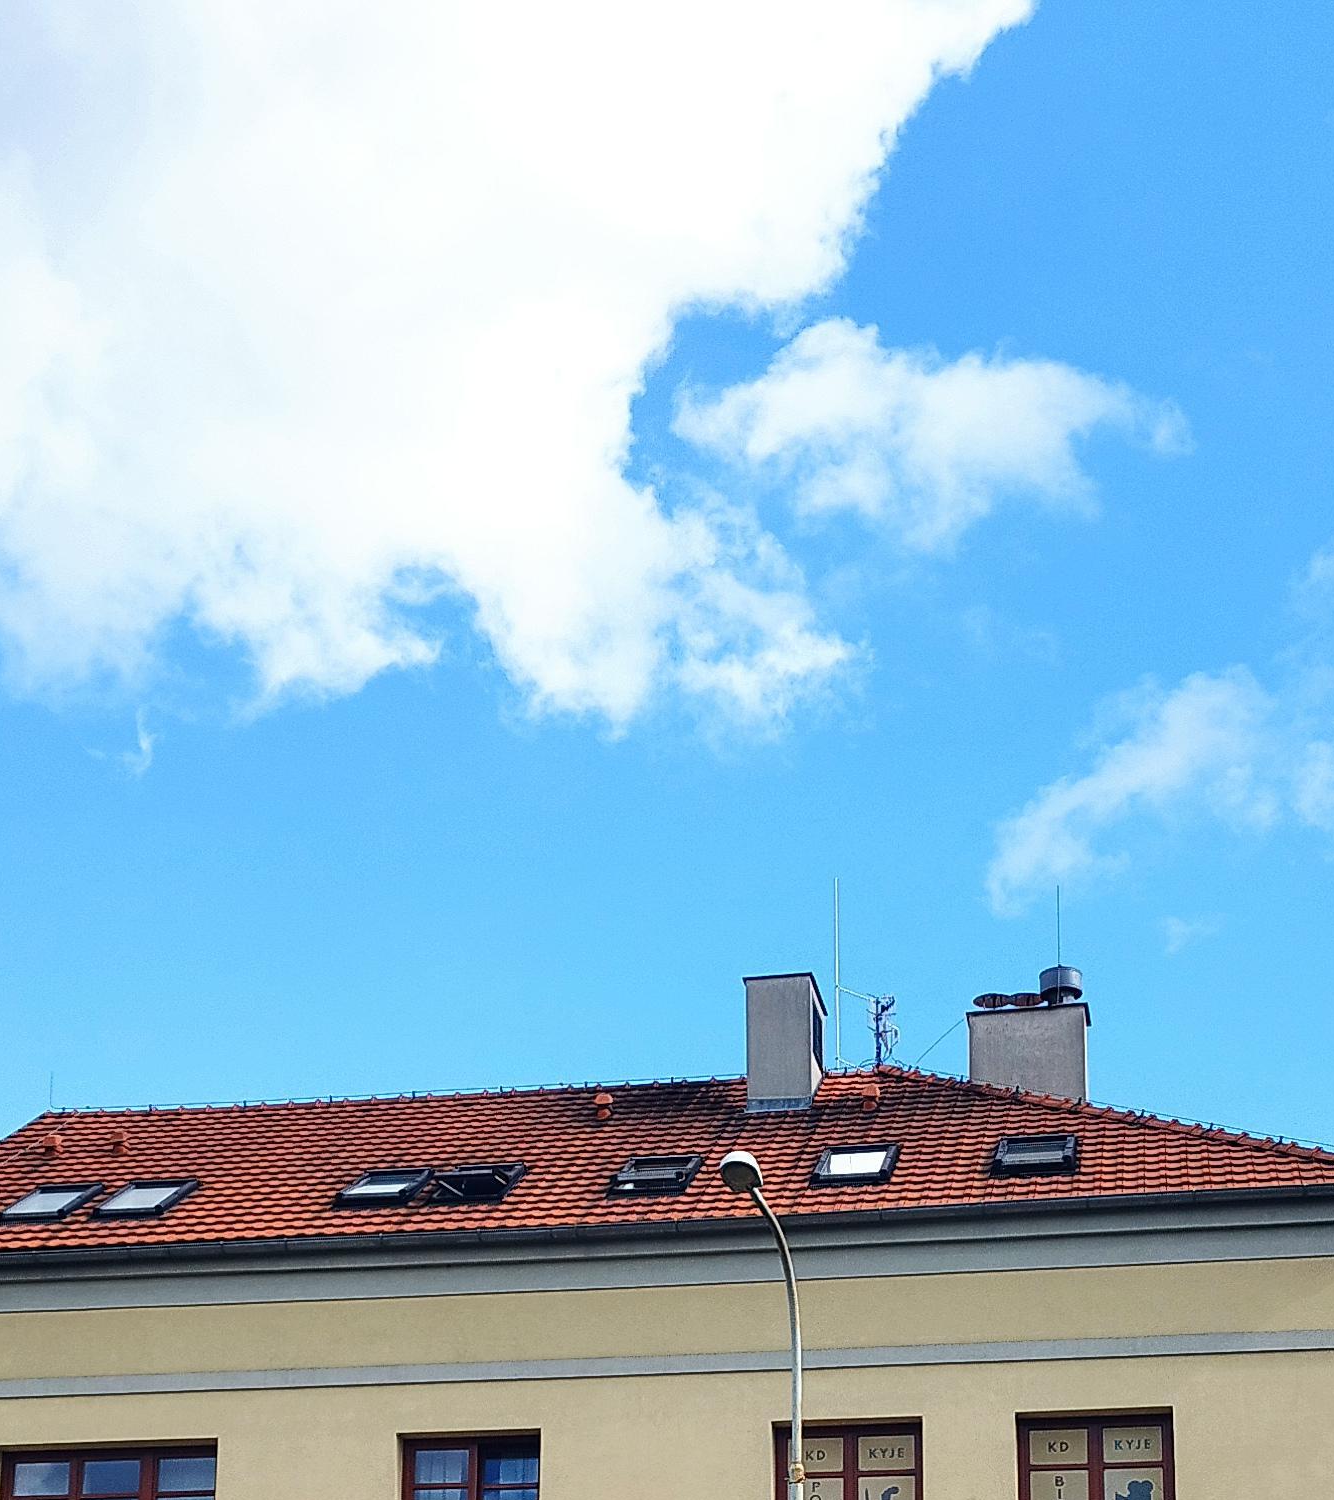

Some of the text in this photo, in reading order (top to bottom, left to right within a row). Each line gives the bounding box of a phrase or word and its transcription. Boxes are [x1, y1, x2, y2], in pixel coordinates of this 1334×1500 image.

[1048, 1438, 1151, 1453] KD KYJE
[805, 1447, 905, 1461] KD KYJE
